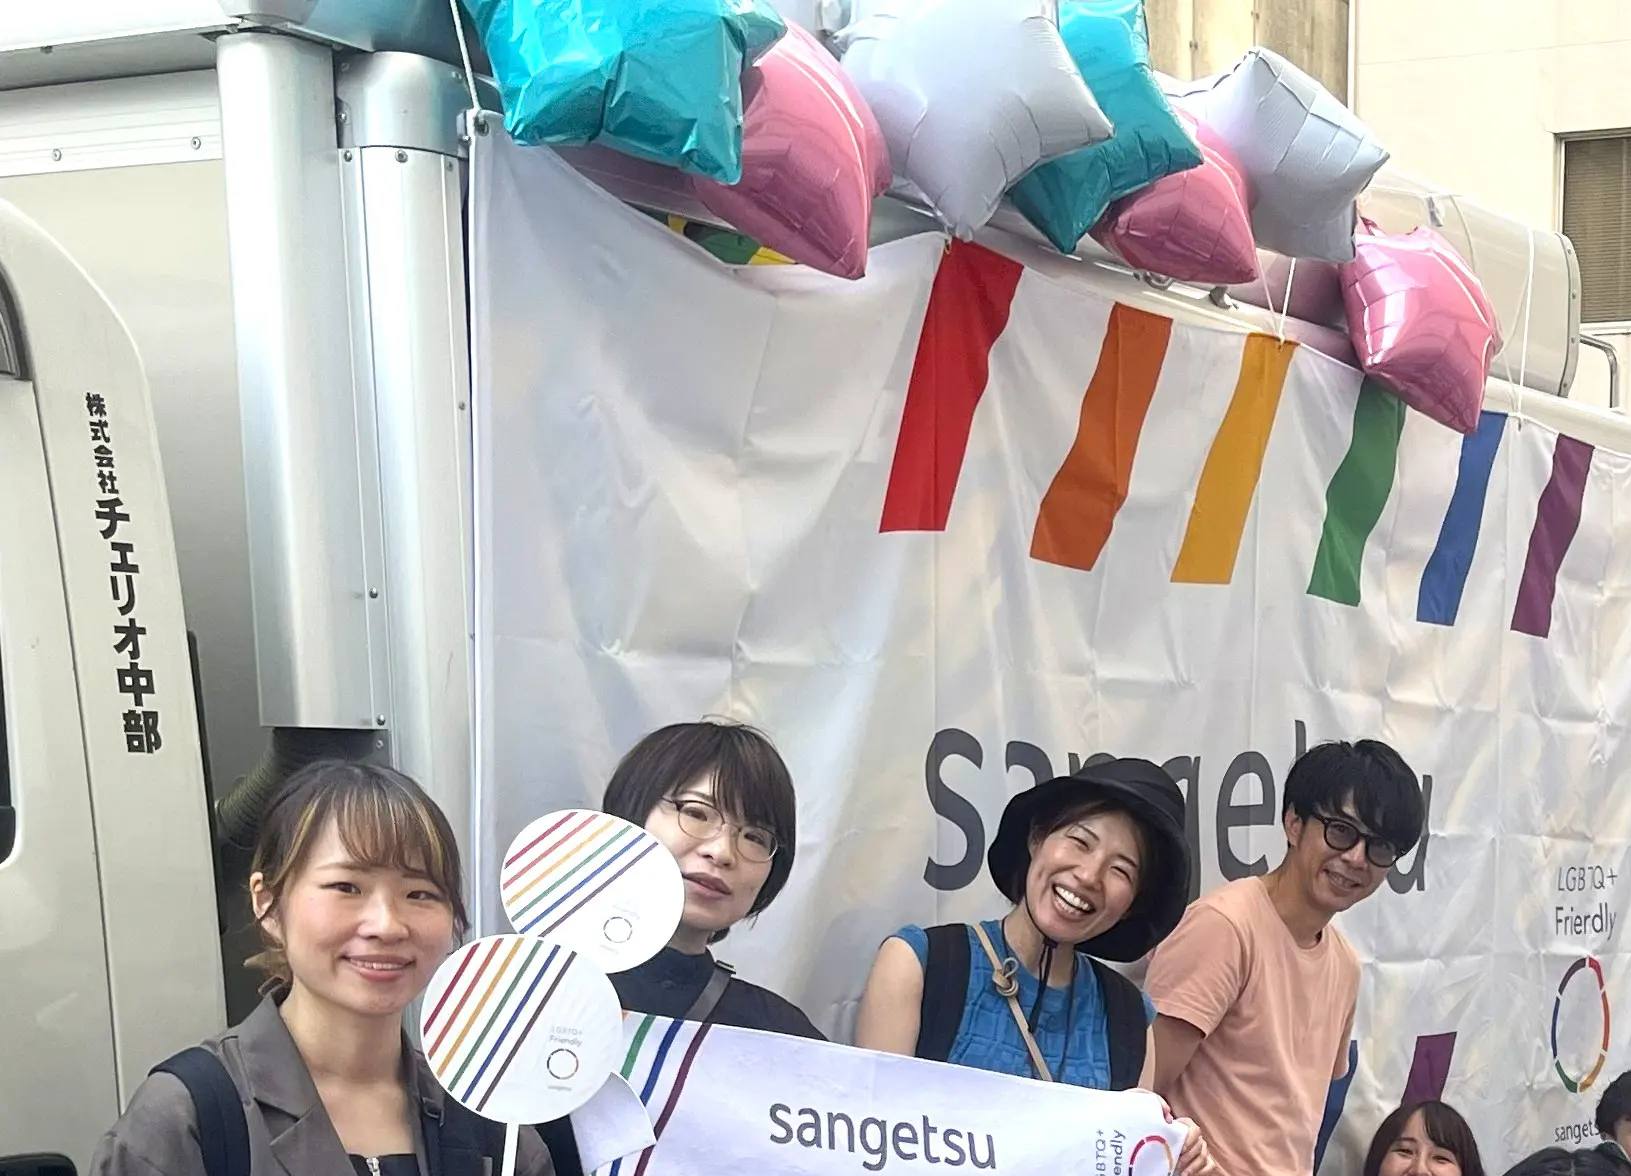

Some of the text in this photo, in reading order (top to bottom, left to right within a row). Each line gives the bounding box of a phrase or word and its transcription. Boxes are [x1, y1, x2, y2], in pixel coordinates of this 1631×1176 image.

[85, 392, 163, 754] 株式会社チェリオ中部
[1557, 865, 1618, 892] LGBTQ+
[769, 1101, 998, 1171] sangetsu
